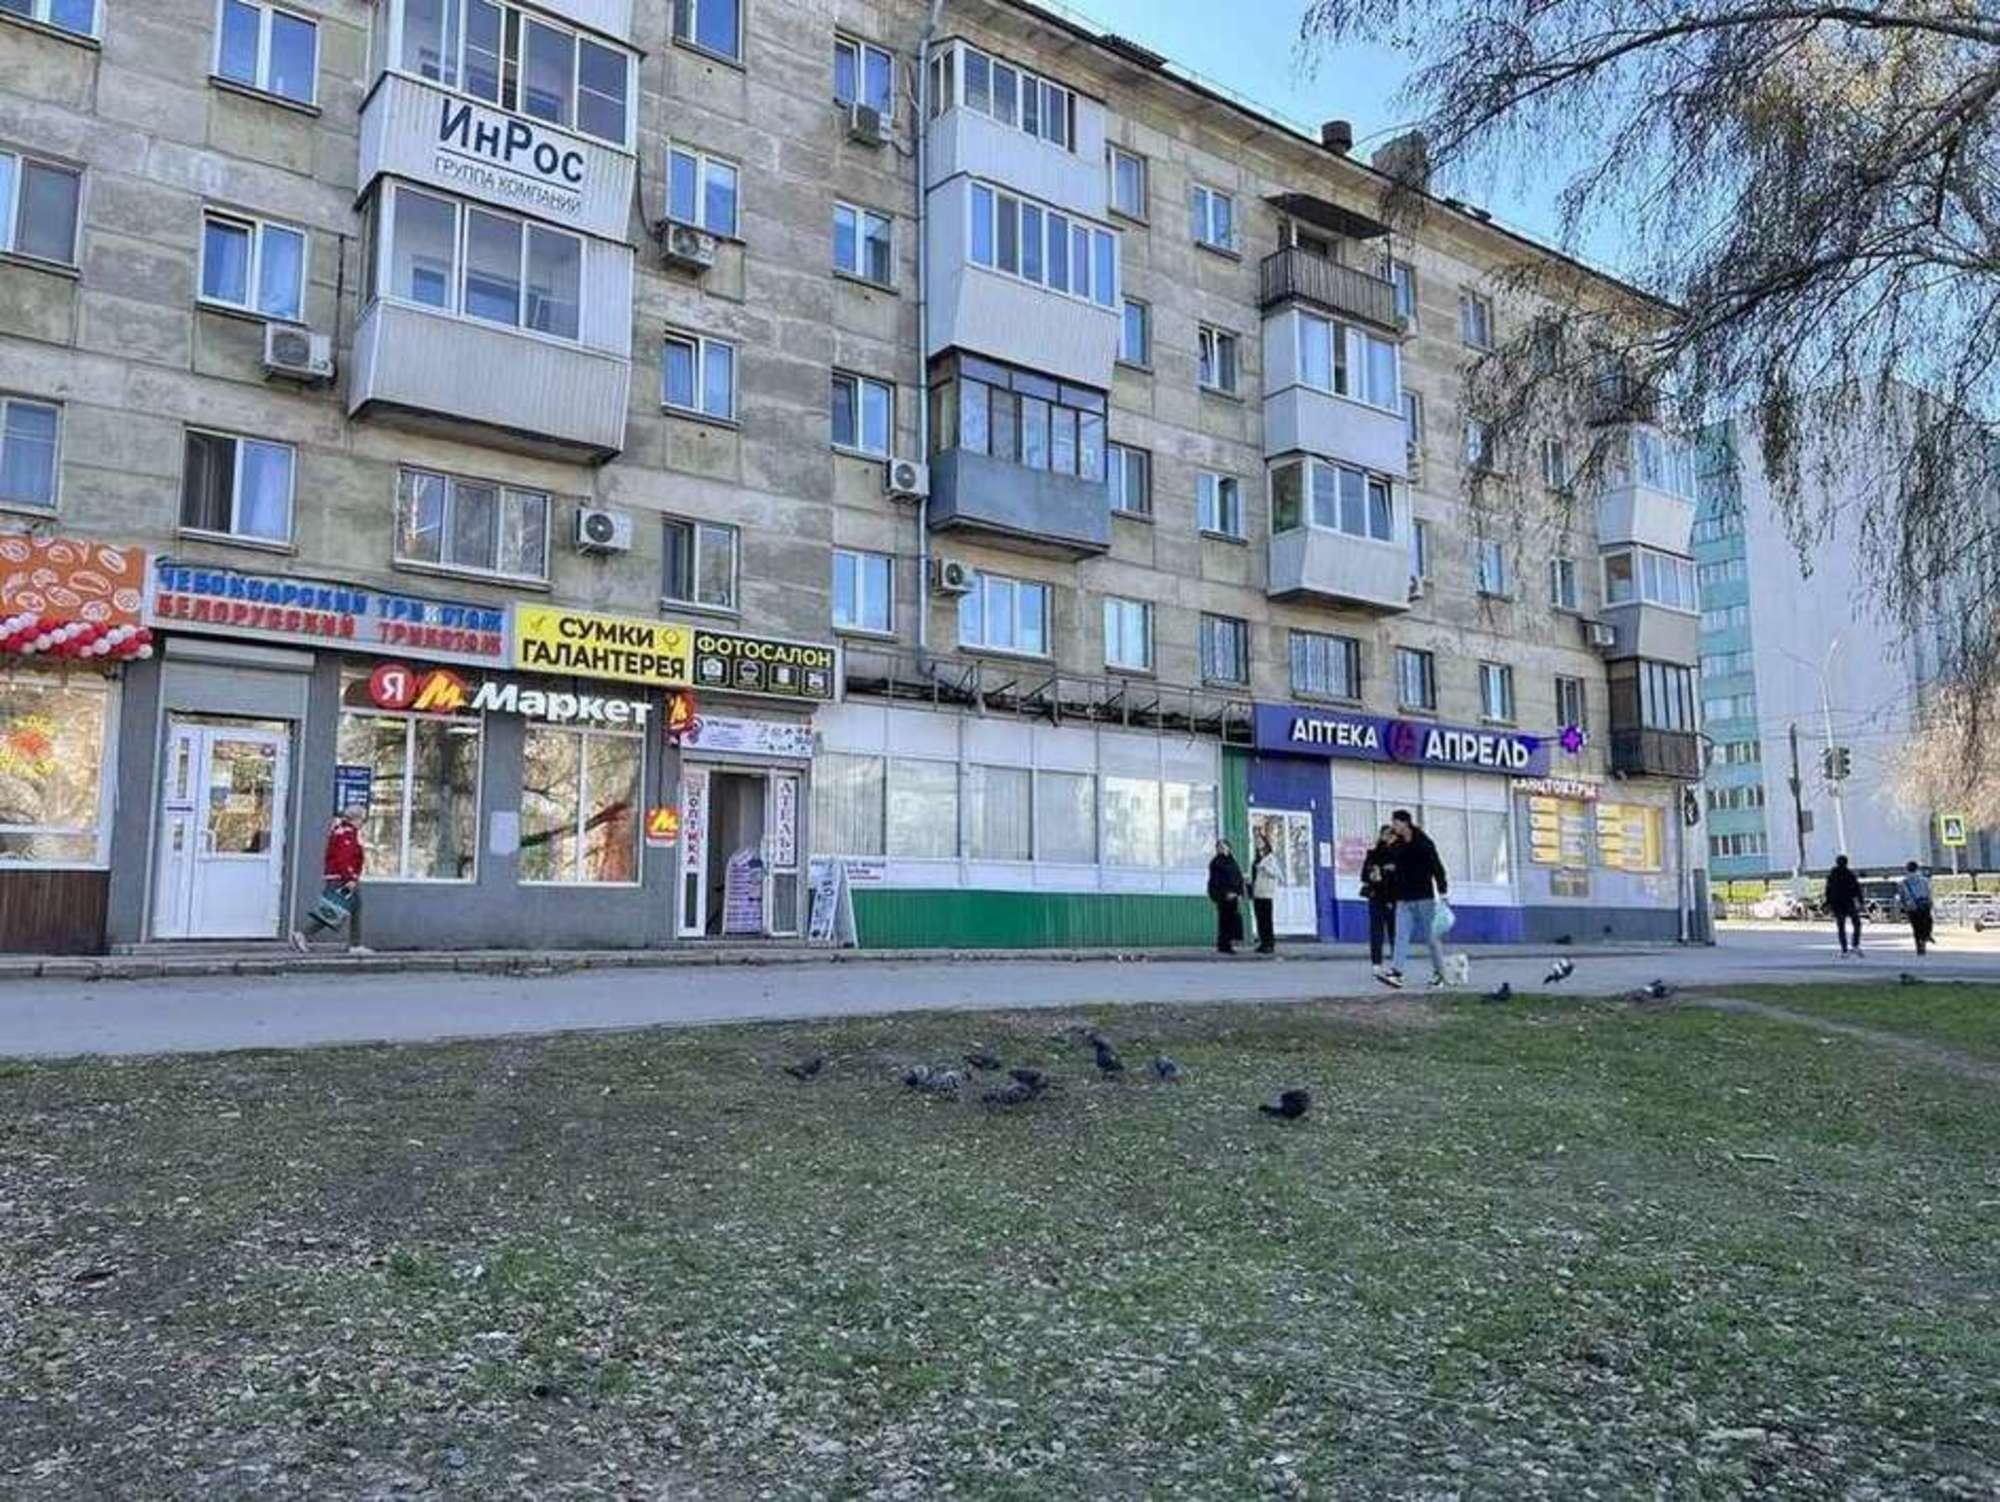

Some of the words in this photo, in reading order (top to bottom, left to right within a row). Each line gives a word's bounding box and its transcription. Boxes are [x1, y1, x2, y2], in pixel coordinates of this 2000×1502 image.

[439, 98, 584, 183] ИнРос
[434, 155, 495, 190] ГРУППА
[498, 174, 581, 213] КОМПАНИЙ
[158, 593, 354, 638] БЕЛОРУССКИЙ
[378, 621, 502, 657] ТРИКОТАЖ
[378, 597, 502, 633] ТРИКОТАЖ
[559, 616, 654, 648] СУМКИ
[522, 639, 685, 680] ГАЛАНТЕРЕЯ
[696, 634, 832, 668] ФОТОСАЛОН
[471, 681, 652, 723] Маркет
[1292, 717, 1379, 749] АПТЕКА
[1424, 729, 1529, 769] АПРЕЛЬ
